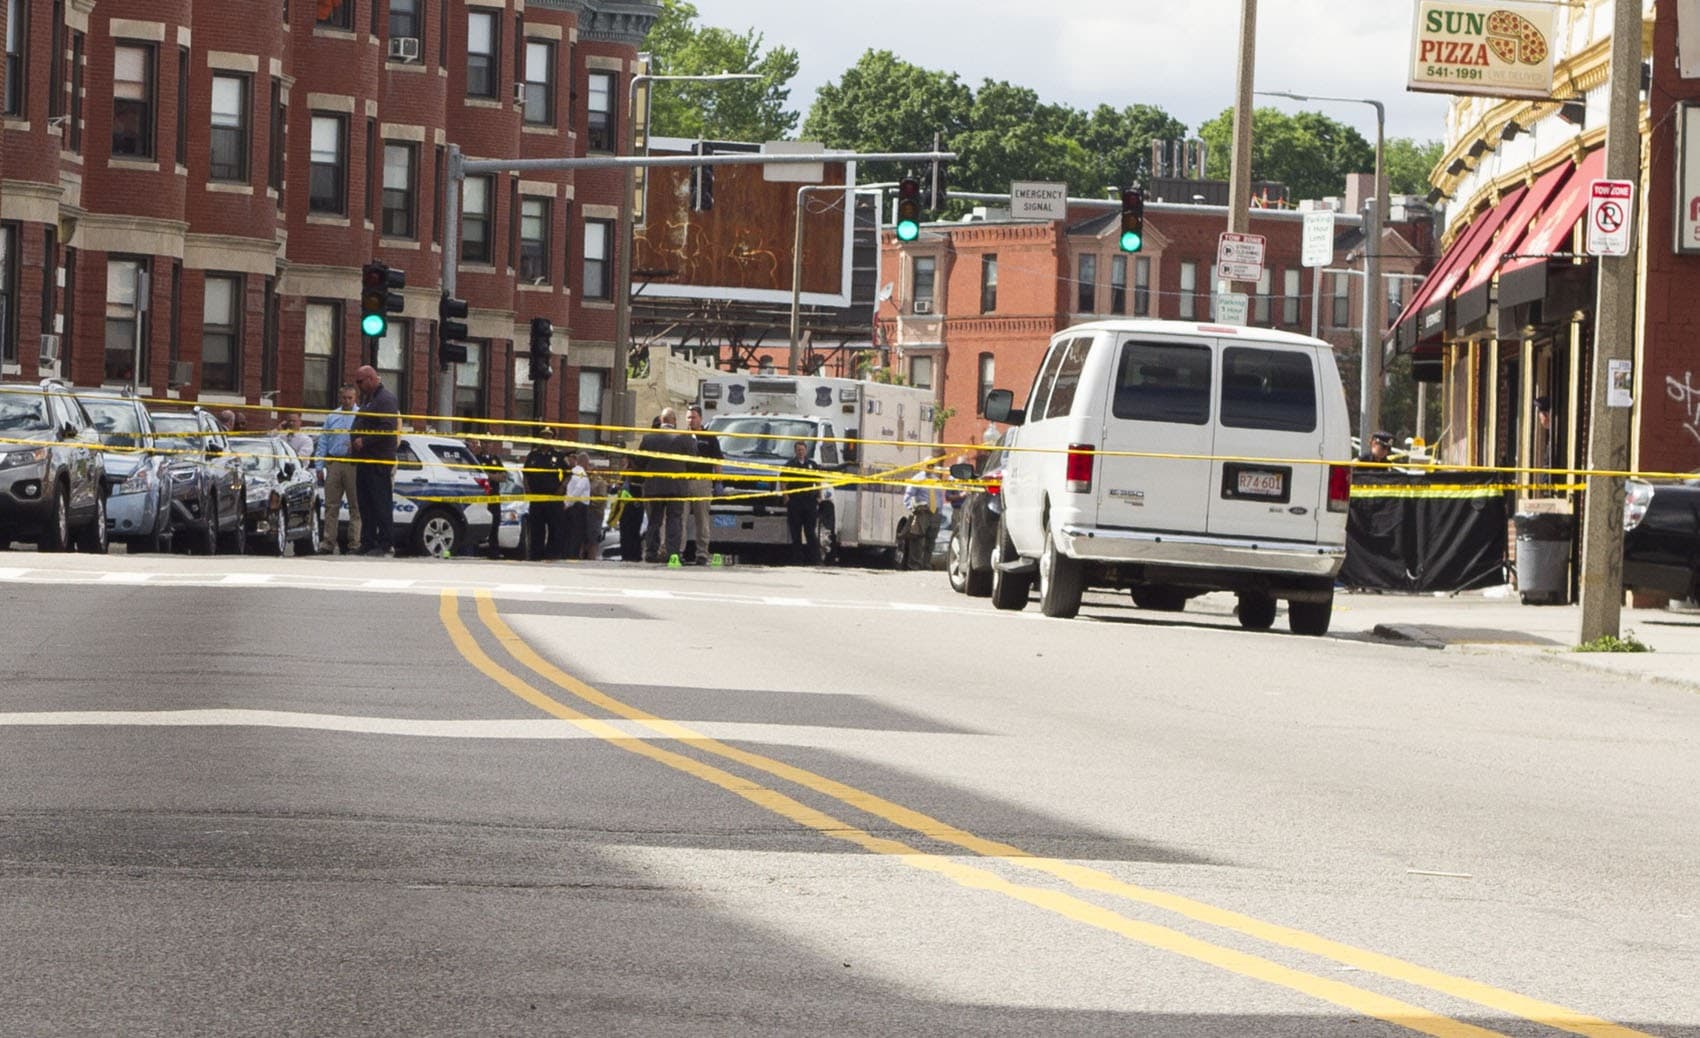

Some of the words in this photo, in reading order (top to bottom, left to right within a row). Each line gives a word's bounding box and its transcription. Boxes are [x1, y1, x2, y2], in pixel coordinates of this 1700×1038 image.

[1426, 9, 1485, 36] SUN
[1419, 40, 1489, 66] PIZZA
[1427, 66, 1482, 79] 541-1991
[1015, 189, 1063, 200] EMERGENCY
[1594, 185, 1610, 195] TOW
[1610, 186, 1629, 196] ZONE
[1023, 202, 1053, 212] SIGNAL
